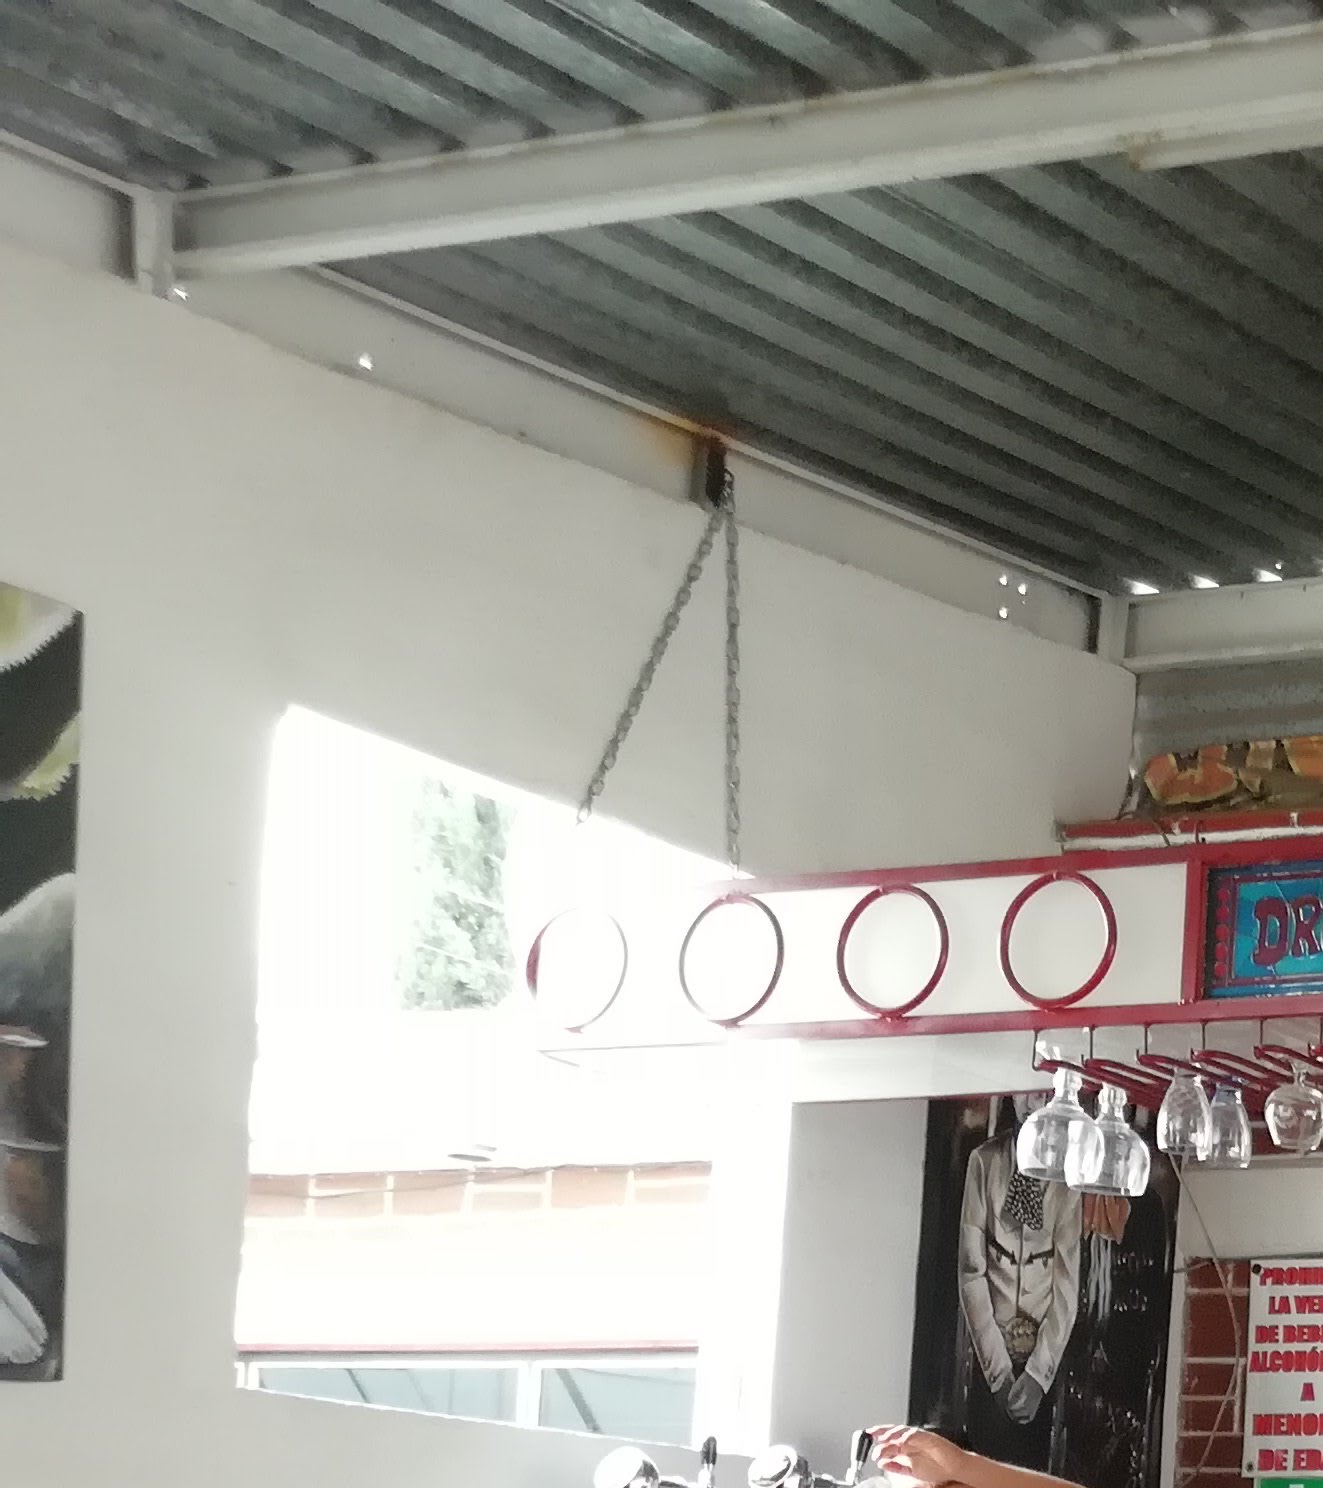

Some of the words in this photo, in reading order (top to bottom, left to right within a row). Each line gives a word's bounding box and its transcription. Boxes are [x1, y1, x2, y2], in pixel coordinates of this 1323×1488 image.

[1268, 1296, 1291, 1315] LA
[1255, 1325, 1279, 1343] DE
[1300, 1383, 1315, 1402] A
[1257, 1449, 1288, 1472] DE
